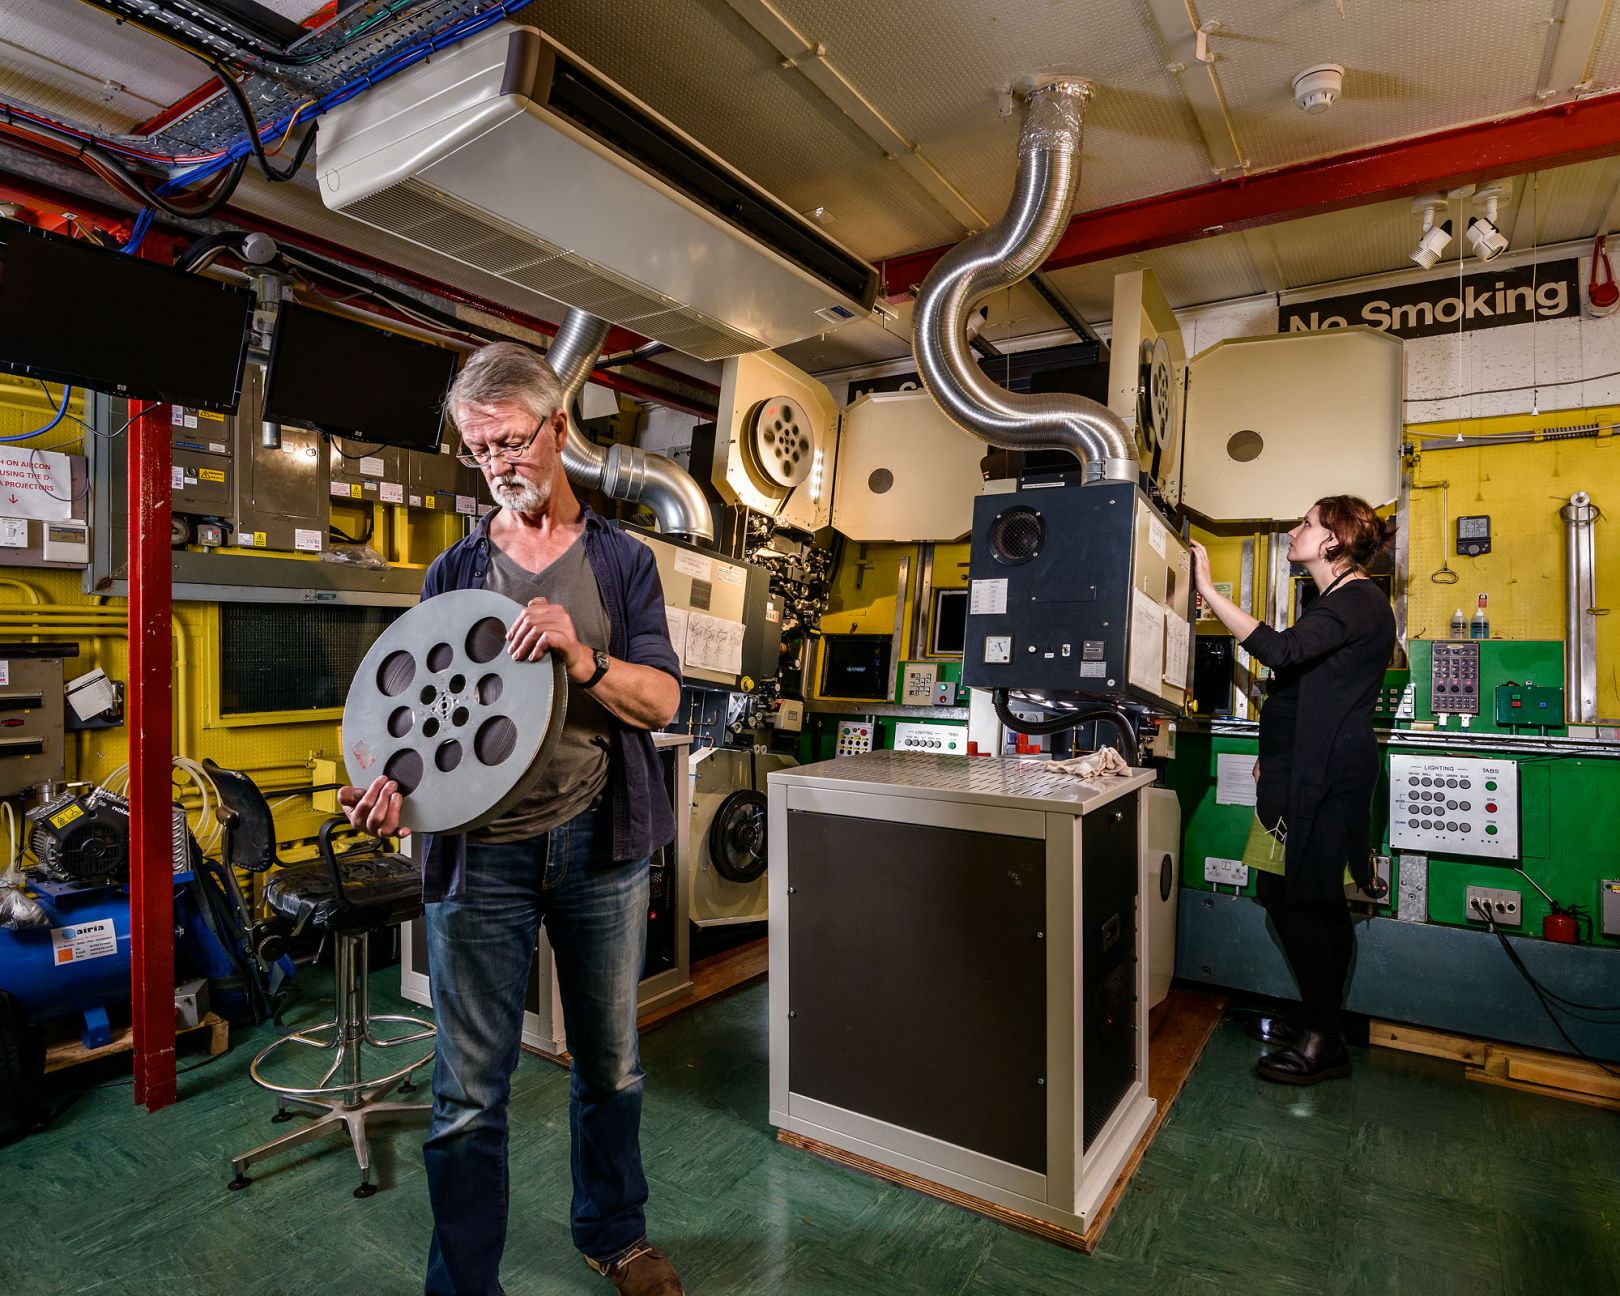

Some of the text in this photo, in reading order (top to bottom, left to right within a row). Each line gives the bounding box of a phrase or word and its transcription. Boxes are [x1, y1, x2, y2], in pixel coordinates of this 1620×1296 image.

[1361, 281, 1568, 332] Smoking
[20, 461, 51, 470] AIRCON
[0, 470, 25, 478] USING
[27, 472, 41, 480] THE
[5, 481, 54, 492] PROJECTORS
[76, 925, 105, 935] airia
